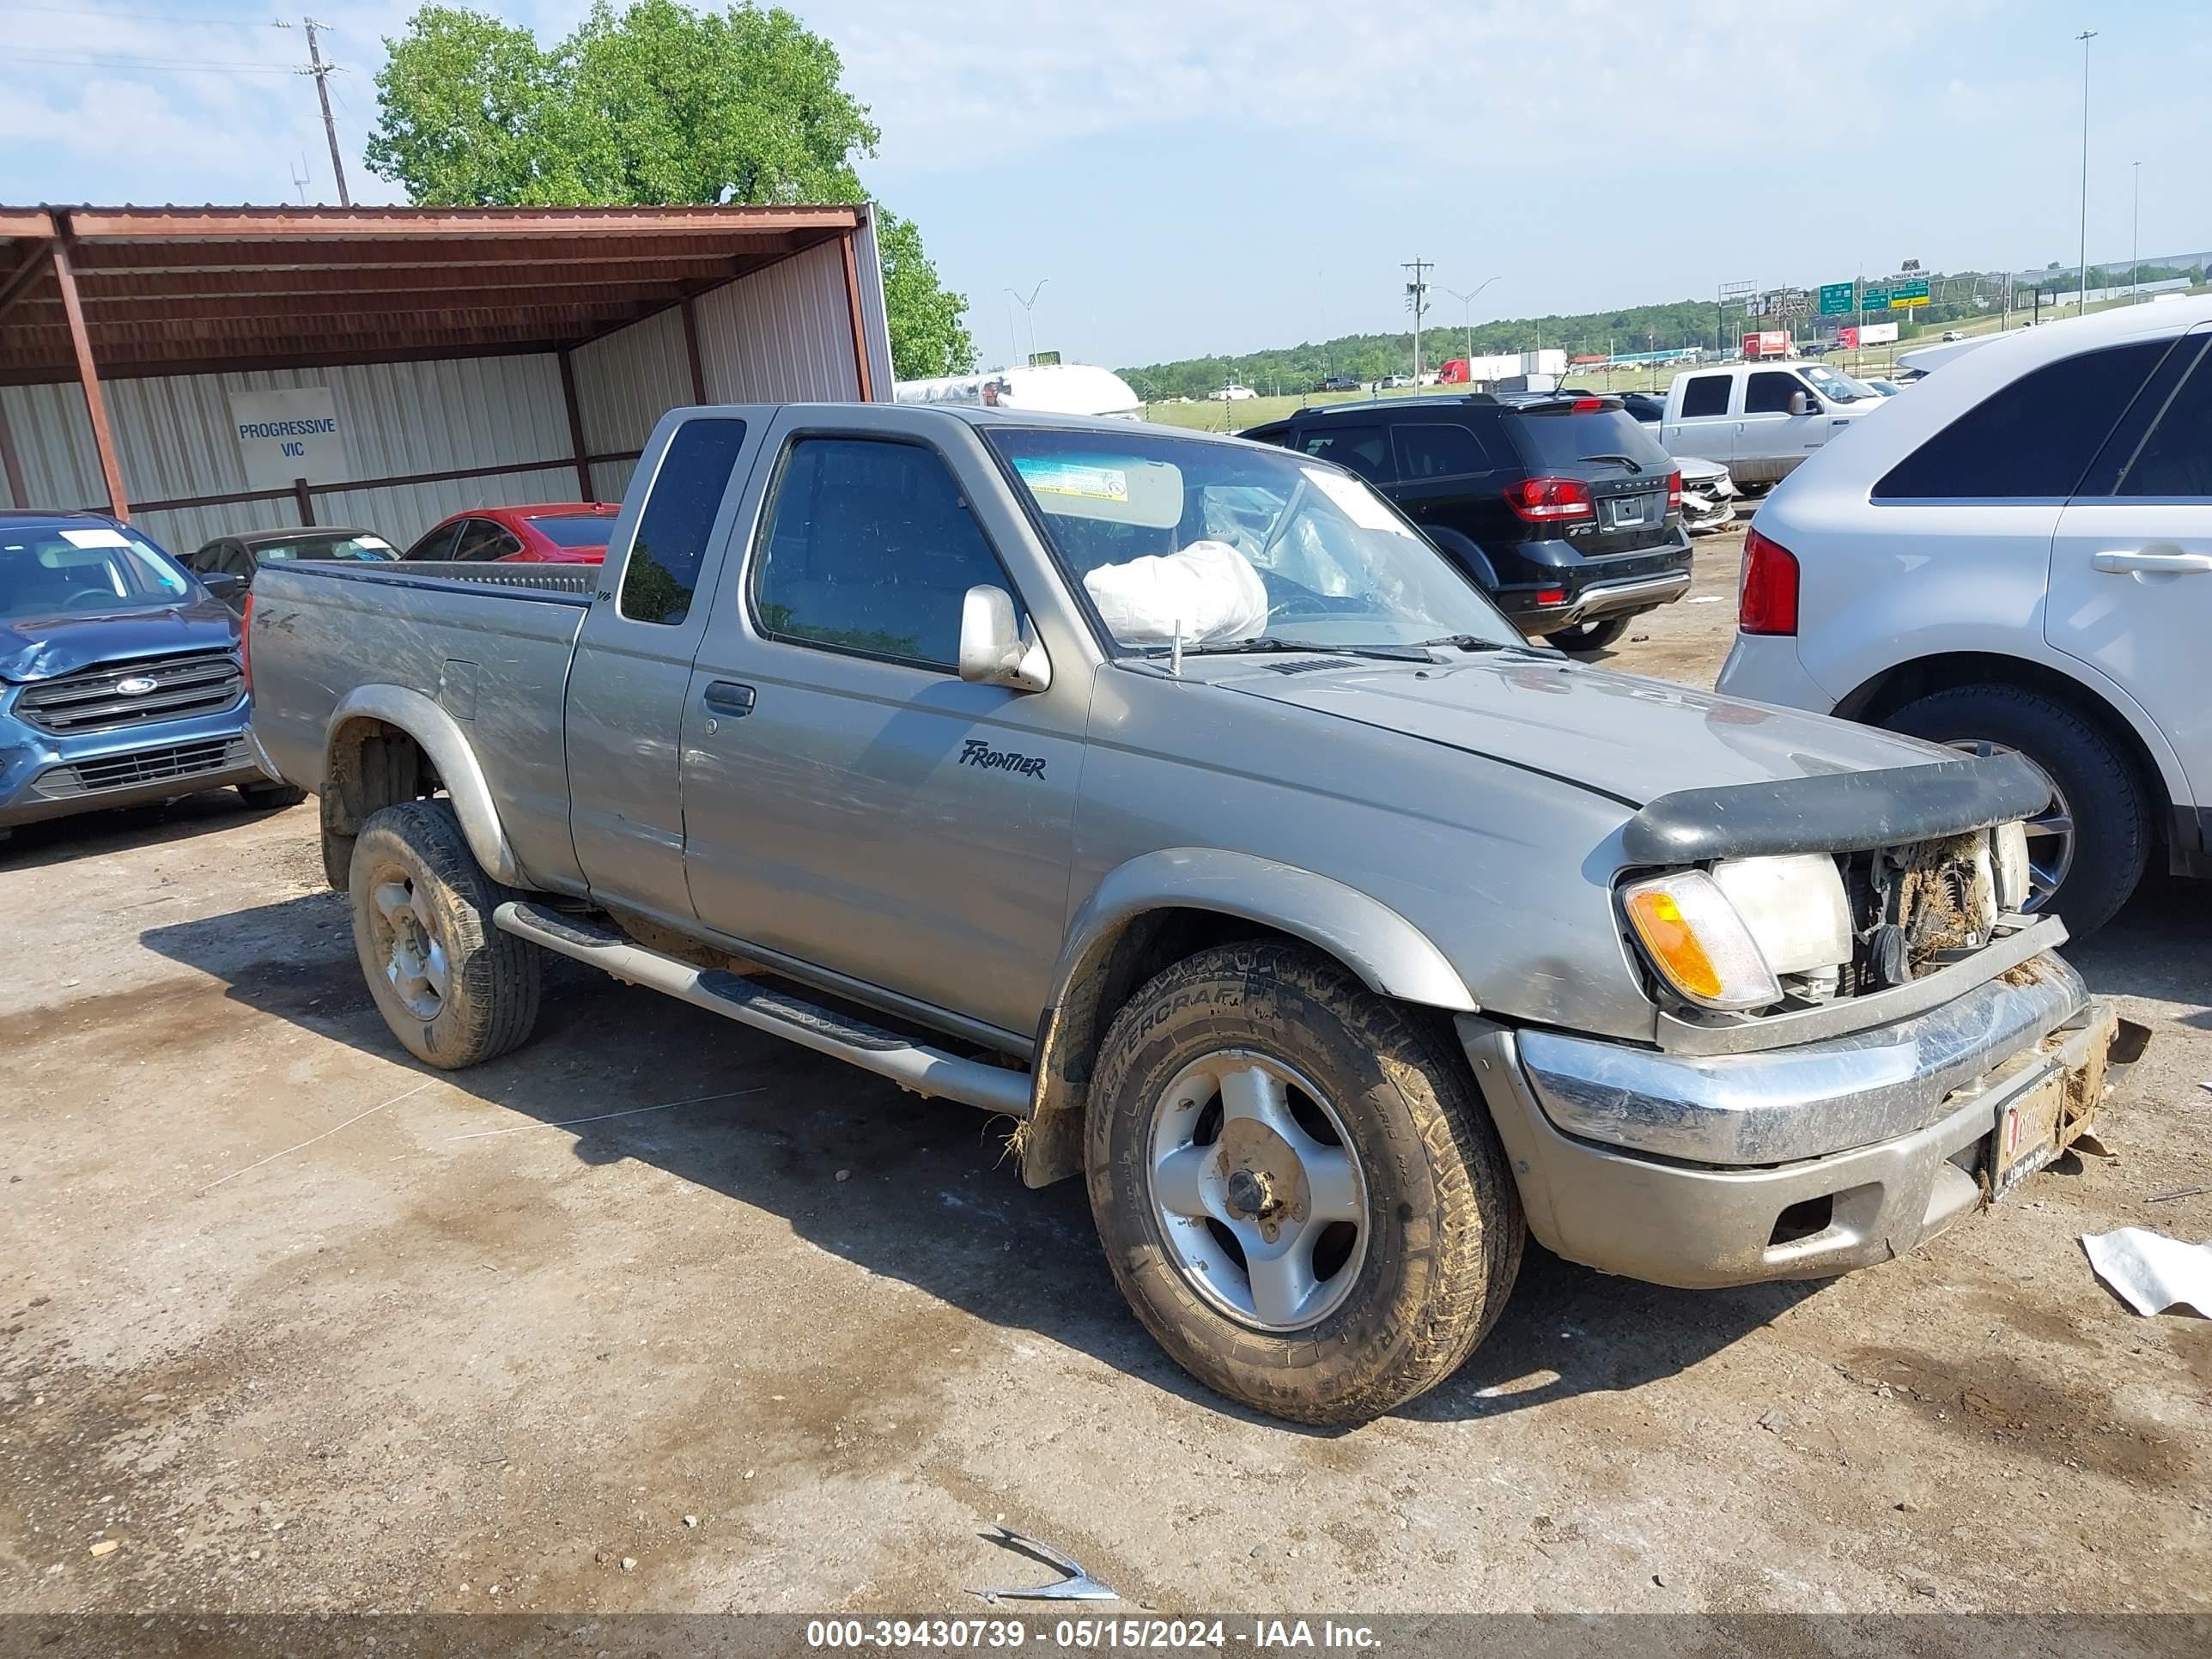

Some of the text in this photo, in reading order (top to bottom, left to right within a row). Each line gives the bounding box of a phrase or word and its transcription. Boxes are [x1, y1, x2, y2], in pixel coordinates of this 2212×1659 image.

[240, 418, 336, 439] PROGRESSIVE
[281, 442, 304, 457] VIC
[597, 590, 611, 602] V6
